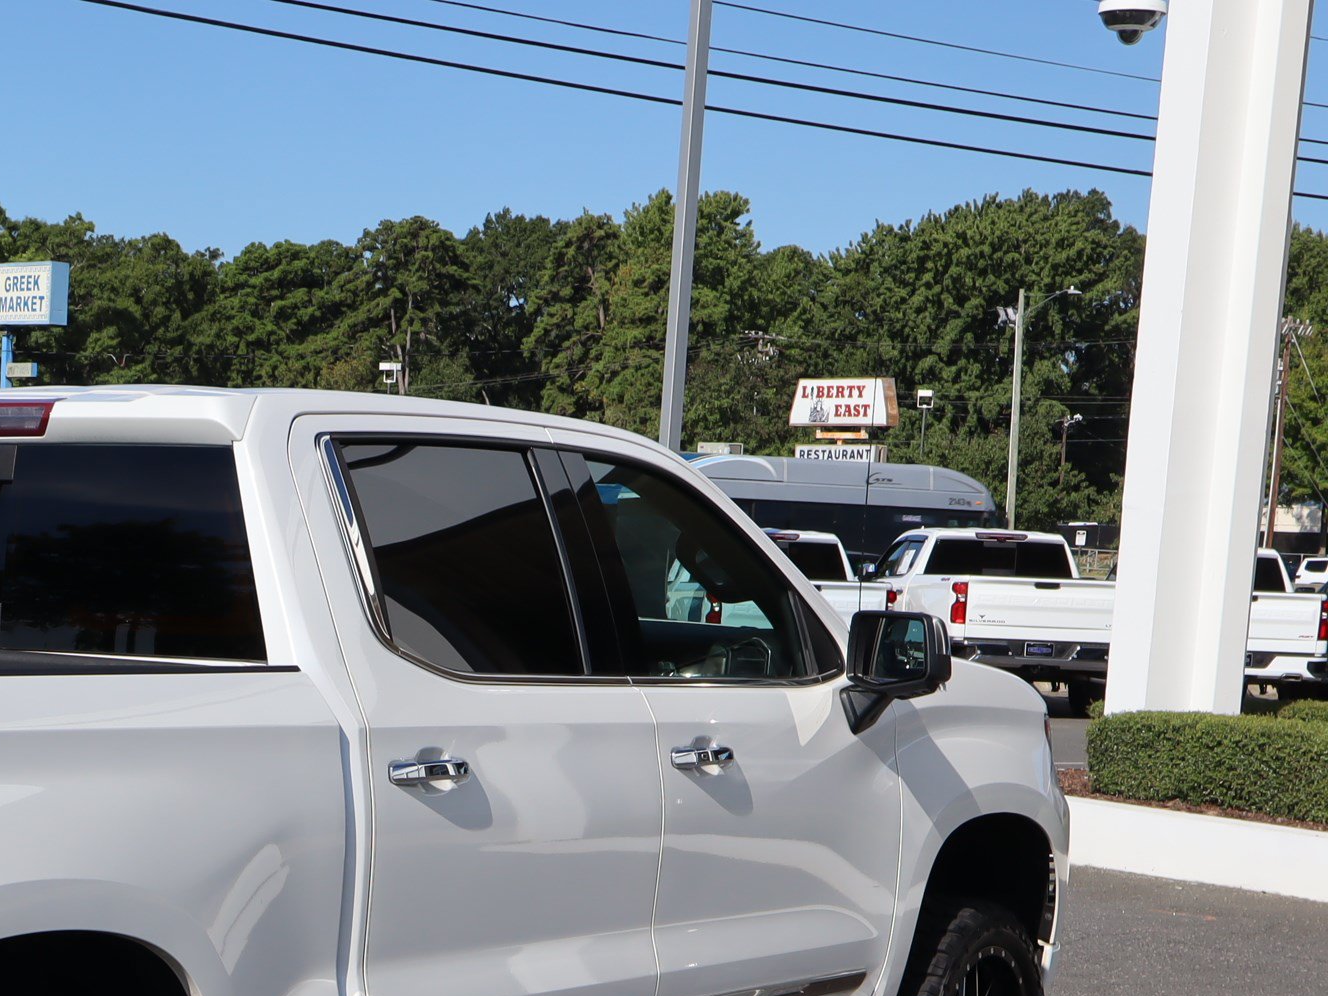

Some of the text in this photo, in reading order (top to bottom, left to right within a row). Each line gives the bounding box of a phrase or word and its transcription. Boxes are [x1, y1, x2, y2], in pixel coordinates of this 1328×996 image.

[4, 275, 40, 292] GREEK
[0, 295, 45, 313] MARKET
[801, 385, 866, 399] LIBERTY
[833, 404, 871, 418] EAST
[799, 448, 871, 460] RESTAURANT
